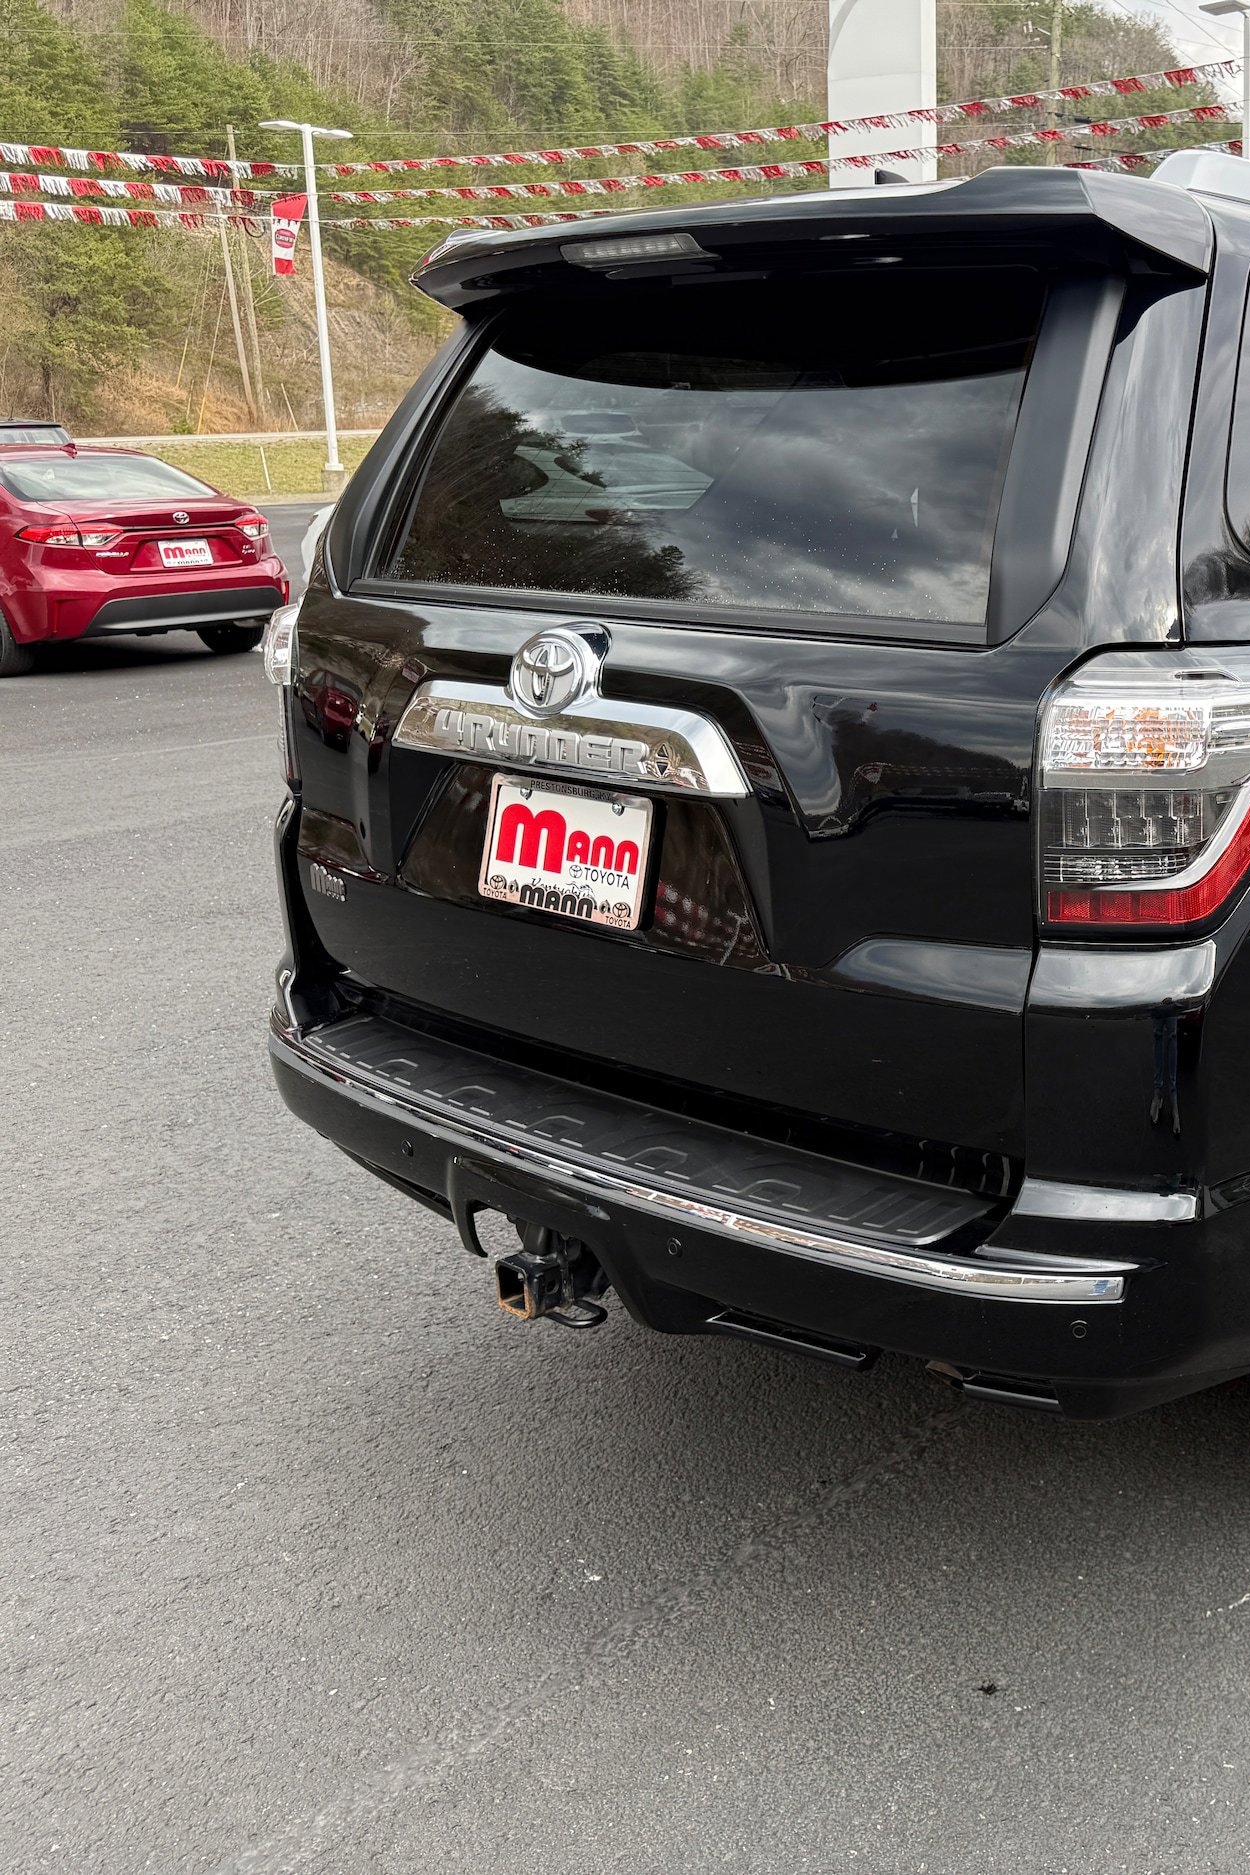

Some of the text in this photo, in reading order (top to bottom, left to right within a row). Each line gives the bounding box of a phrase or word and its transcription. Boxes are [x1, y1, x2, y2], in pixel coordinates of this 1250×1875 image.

[433, 709, 650, 774] 4RUNNER
[584, 867, 630, 890] TOYOTA
[483, 887, 508, 899] TOYOTA
[605, 915, 631, 928] TOYOTA
